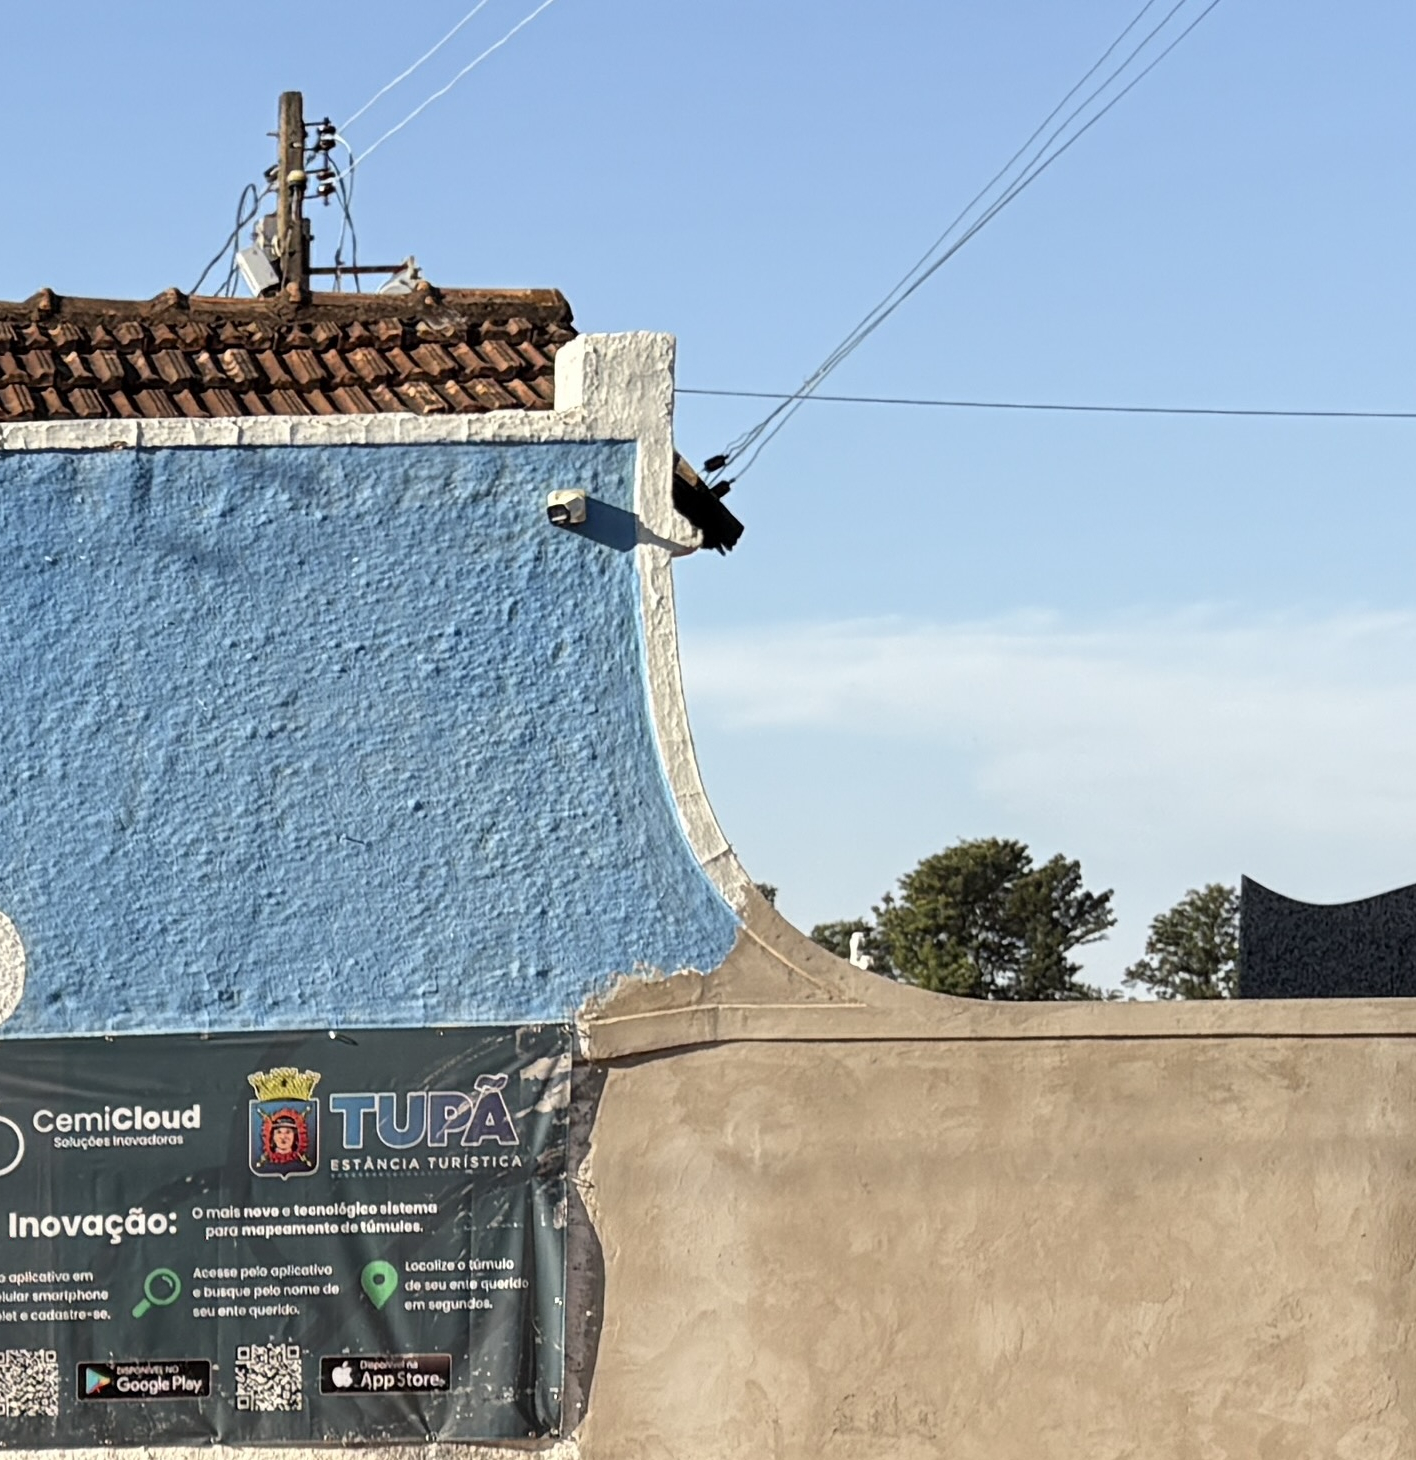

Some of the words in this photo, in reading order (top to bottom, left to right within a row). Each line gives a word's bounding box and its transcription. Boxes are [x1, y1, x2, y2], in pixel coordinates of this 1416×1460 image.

[32, 1104, 201, 1133] CemiCloud
[329, 1072, 520, 1149] TUPÃ
[53, 1135, 110, 1150] Soluções
[112, 1134, 184, 1148] Inovadoras
[330, 1155, 420, 1172] ESTÂNCIA
[427, 1153, 523, 1170] TURÍSTICA
[192, 1207, 203, 1219] O
[206, 1205, 241, 1219] mais
[243, 1206, 280, 1219] novo
[282, 1207, 291, 1218] e
[293, 1202, 377, 1219] tecnológico
[380, 1201, 438, 1216] sistema
[8, 1207, 177, 1245] Inovação:
[205, 1226, 238, 1241] para
[242, 1223, 339, 1239] mapeamento
[341, 1221, 359, 1234] de
[361, 1219, 424, 1234] túmulos.
[193, 1267, 237, 1279] Acesse
[240, 1266, 267, 1280] pelo
[270, 1264, 333, 1279] aplicativo
[405, 1259, 455, 1272] Localize
[457, 1261, 466, 1271] o
[469, 1258, 515, 1271] túmulo
[8, 1271, 70, 1286] aplicativo
[72, 1272, 94, 1282] em
[405, 1280, 421, 1291] de
[425, 1281, 447, 1291] seu
[449, 1279, 477, 1290] ente
[481, 1277, 529, 1292] querido
[32, 1290, 109, 1304] smartphone
[192, 1288, 201, 1298] e
[203, 1286, 251, 1300] busque
[254, 1285, 281, 1299] pelo
[283, 1285, 319, 1296] nome
[323, 1283, 340, 1295] de
[193, 1306, 215, 1317] seu
[217, 1305, 246, 1317] ente
[249, 1303, 300, 1319] querido.
[405, 1300, 425, 1311] em
[428, 1297, 494, 1313] segundos.
[20, 1312, 29, 1321] e
[30, 1309, 112, 1321] cadastre-se.
[116, 1376, 170, 1395] Google
[172, 1375, 202, 1394] Play
[360, 1371, 395, 1390] App
[397, 1371, 439, 1388] Store
